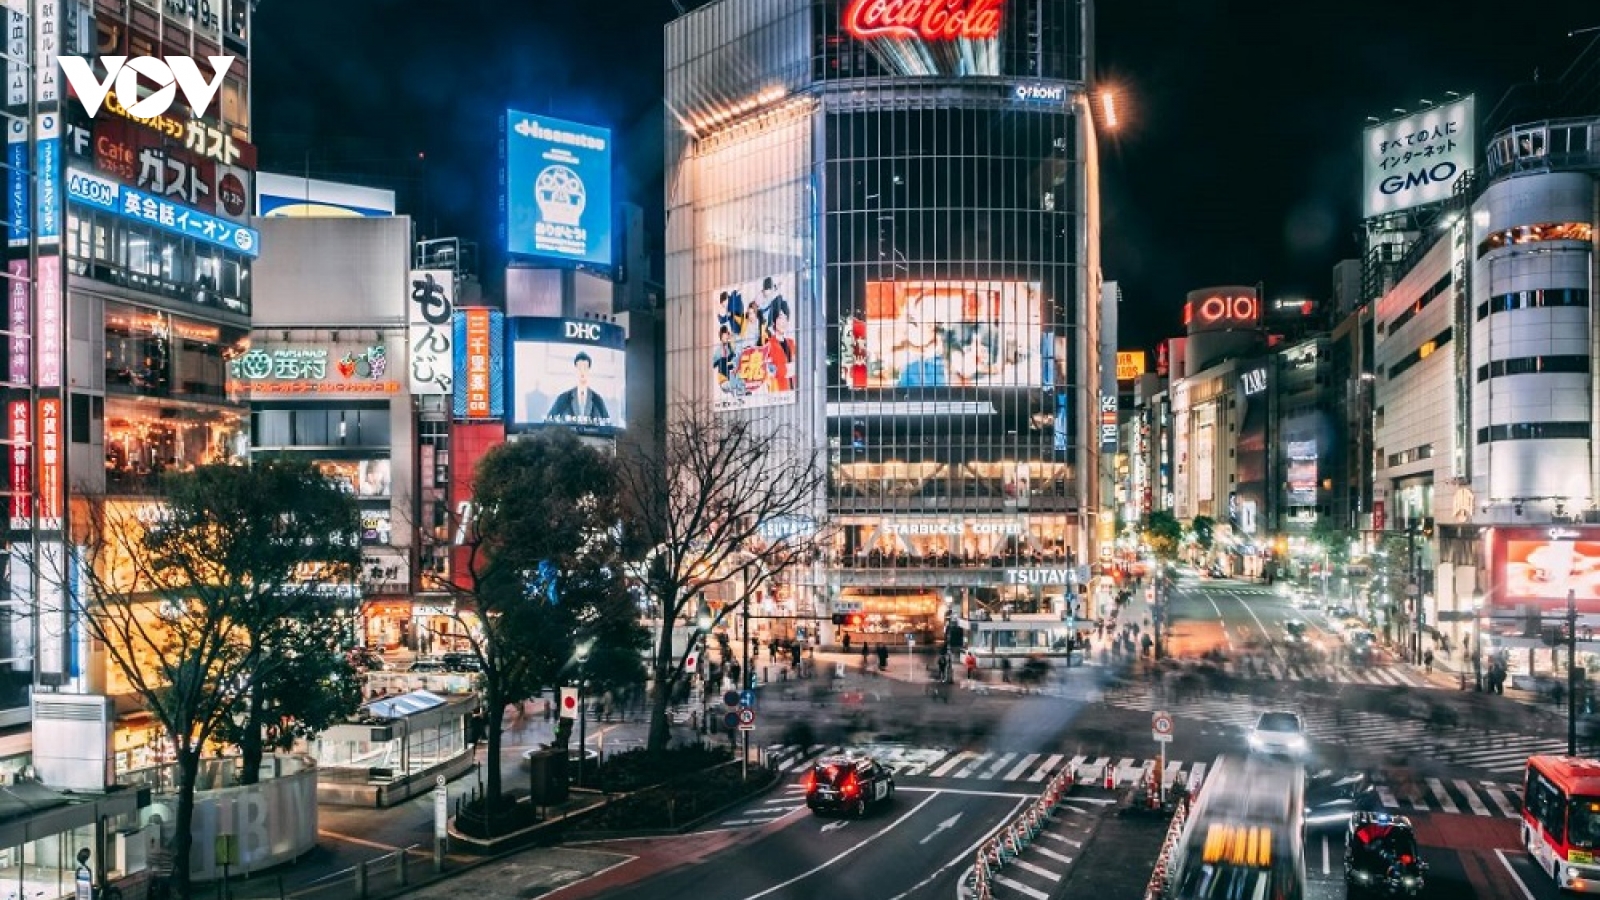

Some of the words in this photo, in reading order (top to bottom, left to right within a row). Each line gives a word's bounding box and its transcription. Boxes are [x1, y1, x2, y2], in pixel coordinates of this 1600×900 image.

[97, 134, 134, 163] Cafe
[186, 120, 241, 164] ガスト
[1380, 121, 1457, 155] すべての人に
[1380, 139, 1457, 171] インターネット
[69, 174, 113, 205] AEON
[137, 147, 209, 204] ガスト
[1380, 161, 1457, 195] GMO
[124, 190, 232, 242] 英会話イーオン
[412, 272, 452, 392] もんじゃ
[564, 321, 601, 340] DHC
[274, 358, 328, 379] 西村
[469, 316, 487, 411] 三千里薬品
[882, 522, 964, 534] STARBUCKS
[973, 523, 1022, 534] COFFEE
[1008, 569, 1077, 584] TSUTAYA
